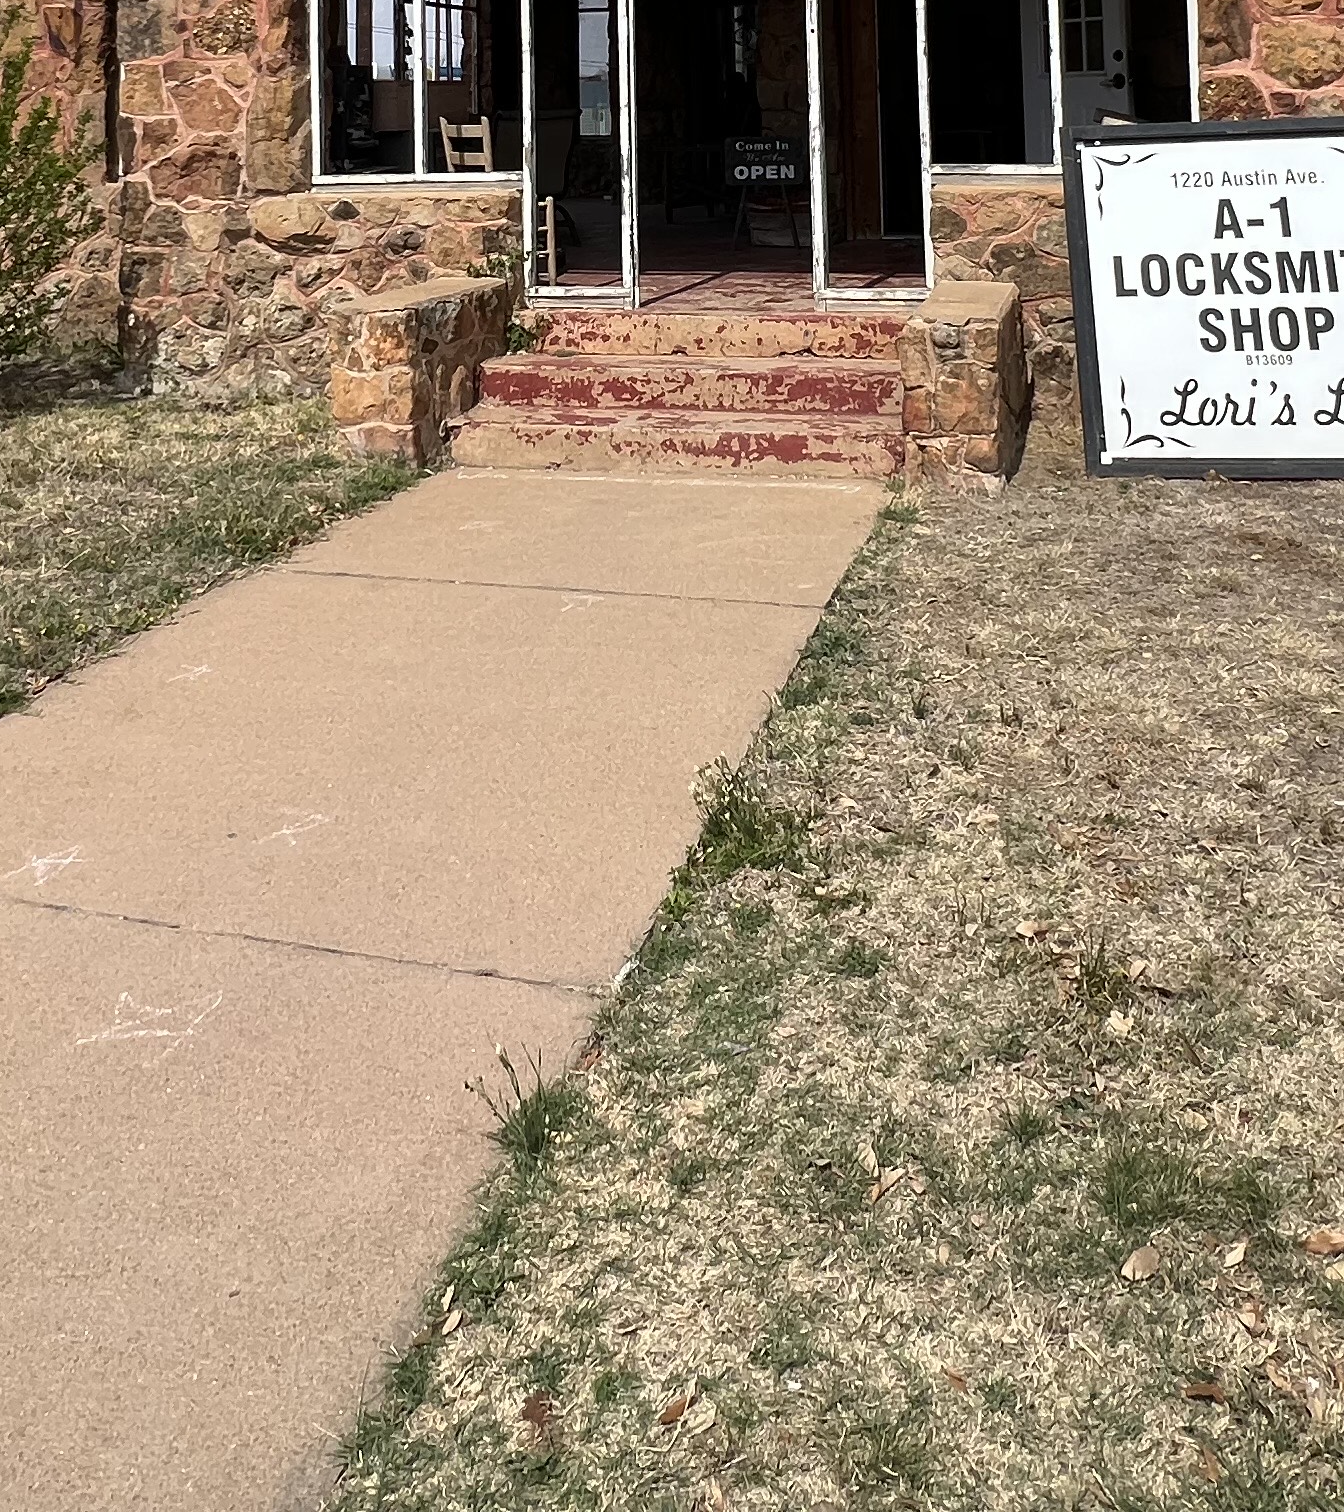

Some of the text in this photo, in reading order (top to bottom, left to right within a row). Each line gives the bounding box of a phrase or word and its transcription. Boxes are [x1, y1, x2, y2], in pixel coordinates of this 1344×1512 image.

[735, 141, 790, 151] Come In
[734, 165, 795, 180] OPEN
[1169, 169, 1325, 188] 1220 Austin Ave.
[1214, 196, 1292, 239] A-1
[1198, 306, 1336, 352] SHOP
[1160, 377, 1297, 427] Lori's
